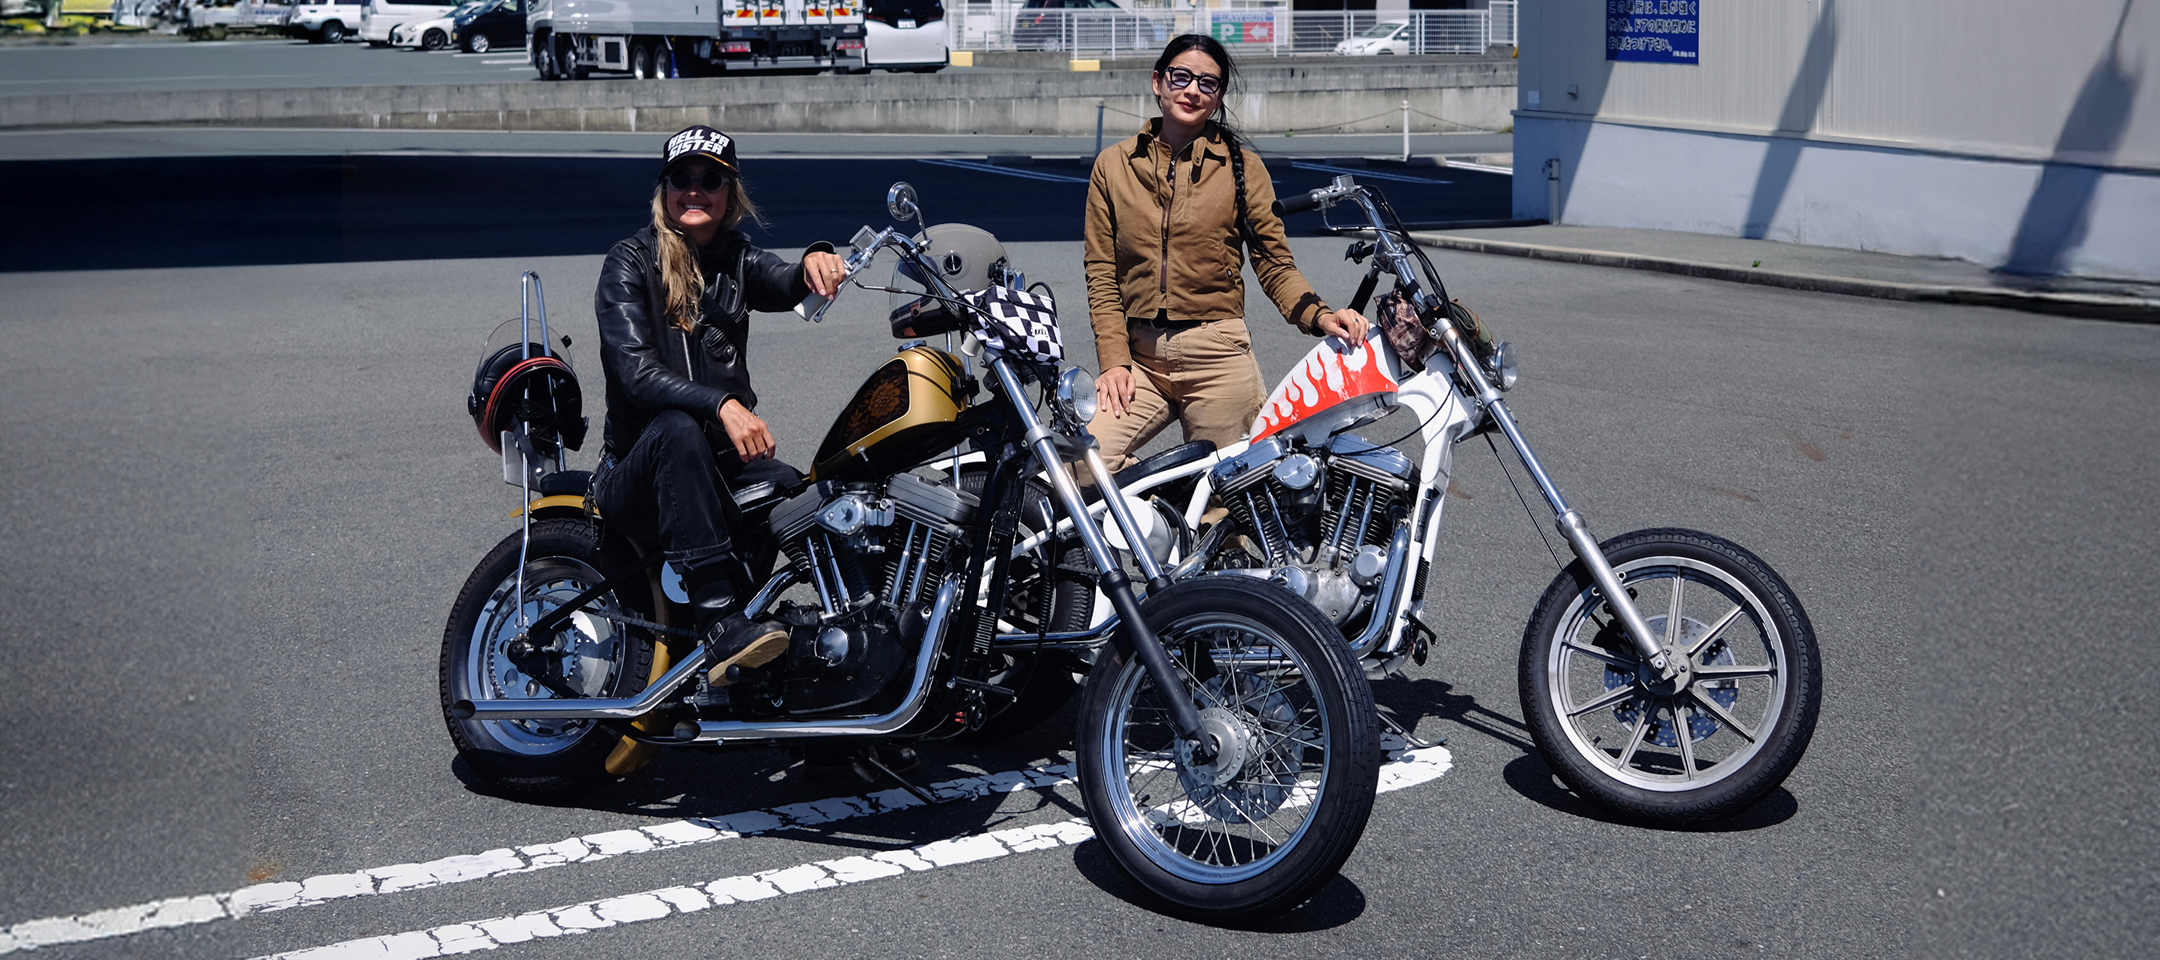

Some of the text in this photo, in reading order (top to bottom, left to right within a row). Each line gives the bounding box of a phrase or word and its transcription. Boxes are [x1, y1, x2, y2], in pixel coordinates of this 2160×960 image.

[1220, 24, 1235, 41] P
[668, 129, 730, 151] HELL YA
[668, 140, 723, 162] SISTER
